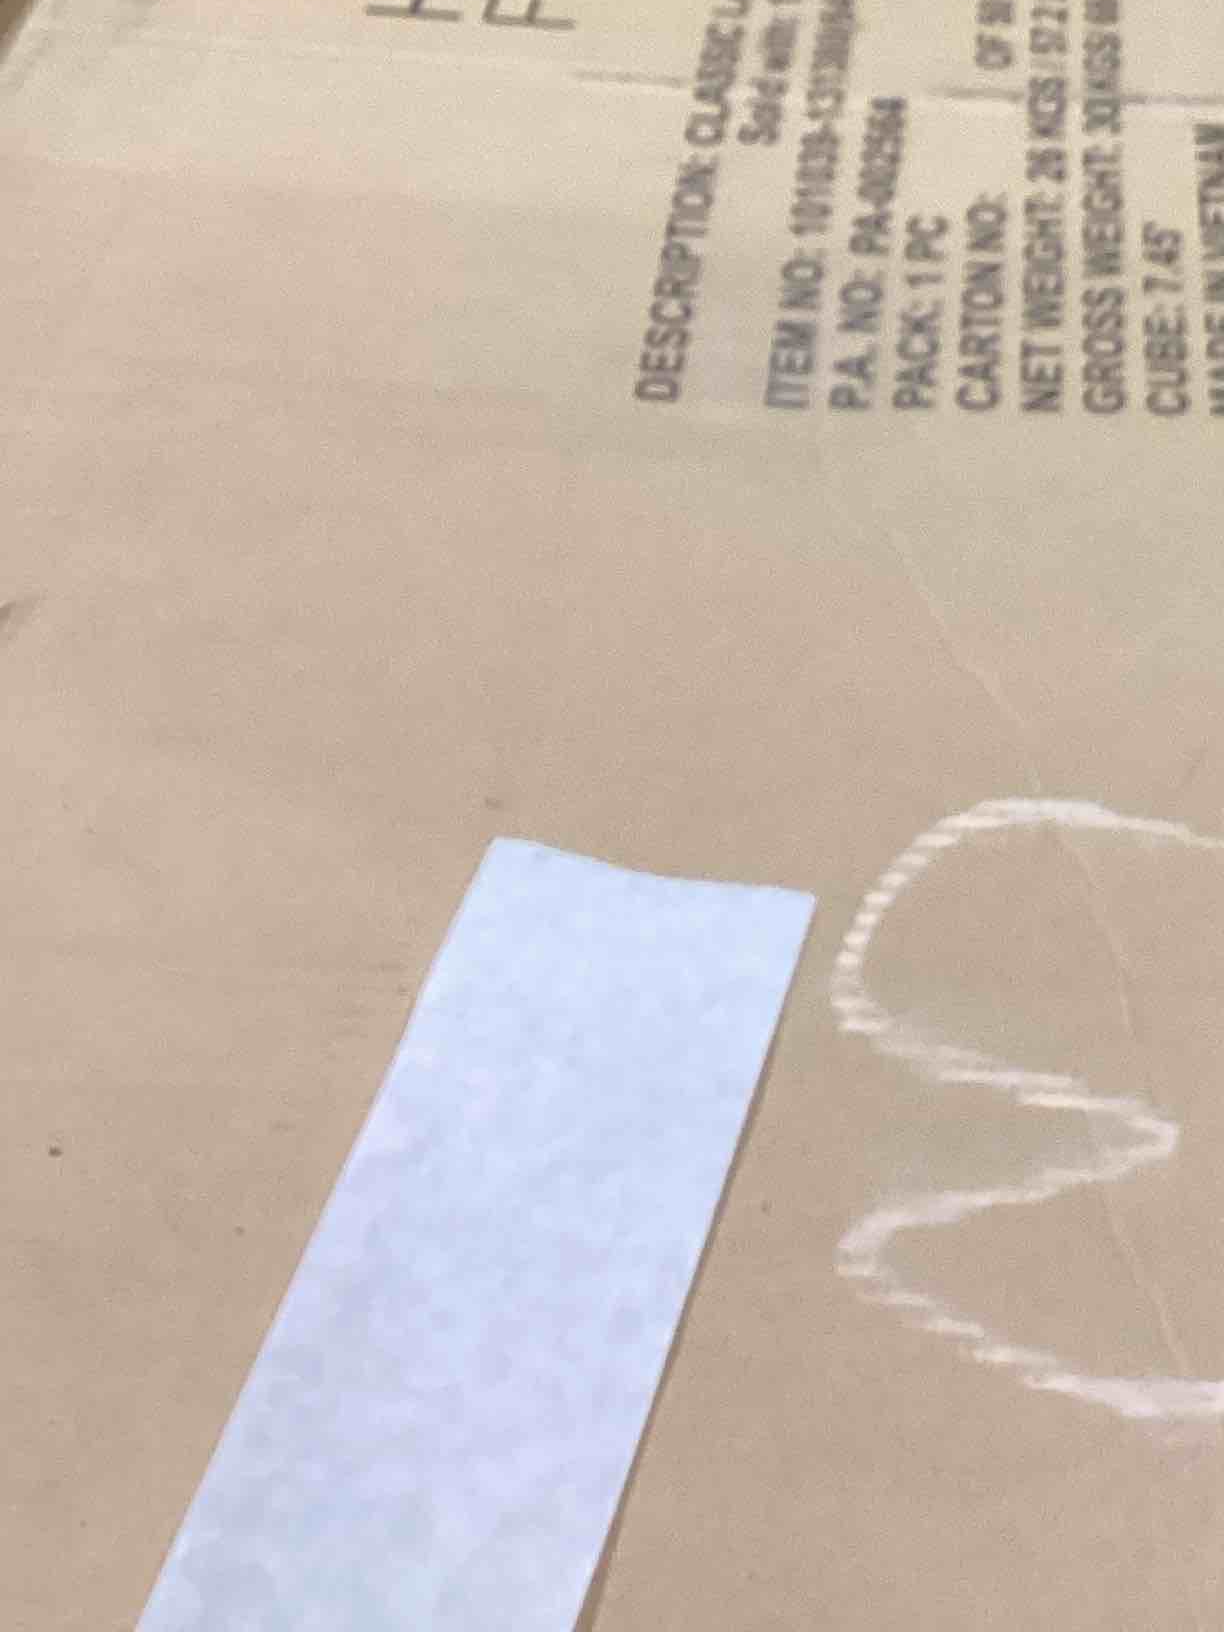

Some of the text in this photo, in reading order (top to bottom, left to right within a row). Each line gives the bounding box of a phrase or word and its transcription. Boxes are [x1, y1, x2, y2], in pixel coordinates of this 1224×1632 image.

[973, 35, 1011, 70] OF
[963, 193, 1006, 255] NO:
[1020, 195, 1064, 333] WEIGHT:
[1082, 145, 1124, 280] WEIGHT:
[632, 160, 720, 403] DESCRIPTION:
[775, 251, 825, 311] NO:
[834, 273, 887, 333] NO:
[889, 216, 945, 410] PACK: 1 PC
[954, 262, 1004, 411] CARTON
[760, 321, 816, 411] ITEM
[1018, 342, 1064, 413] NET
[1081, 288, 1127, 415] GROSS
[1143, 305, 1192, 416] CUBE:
